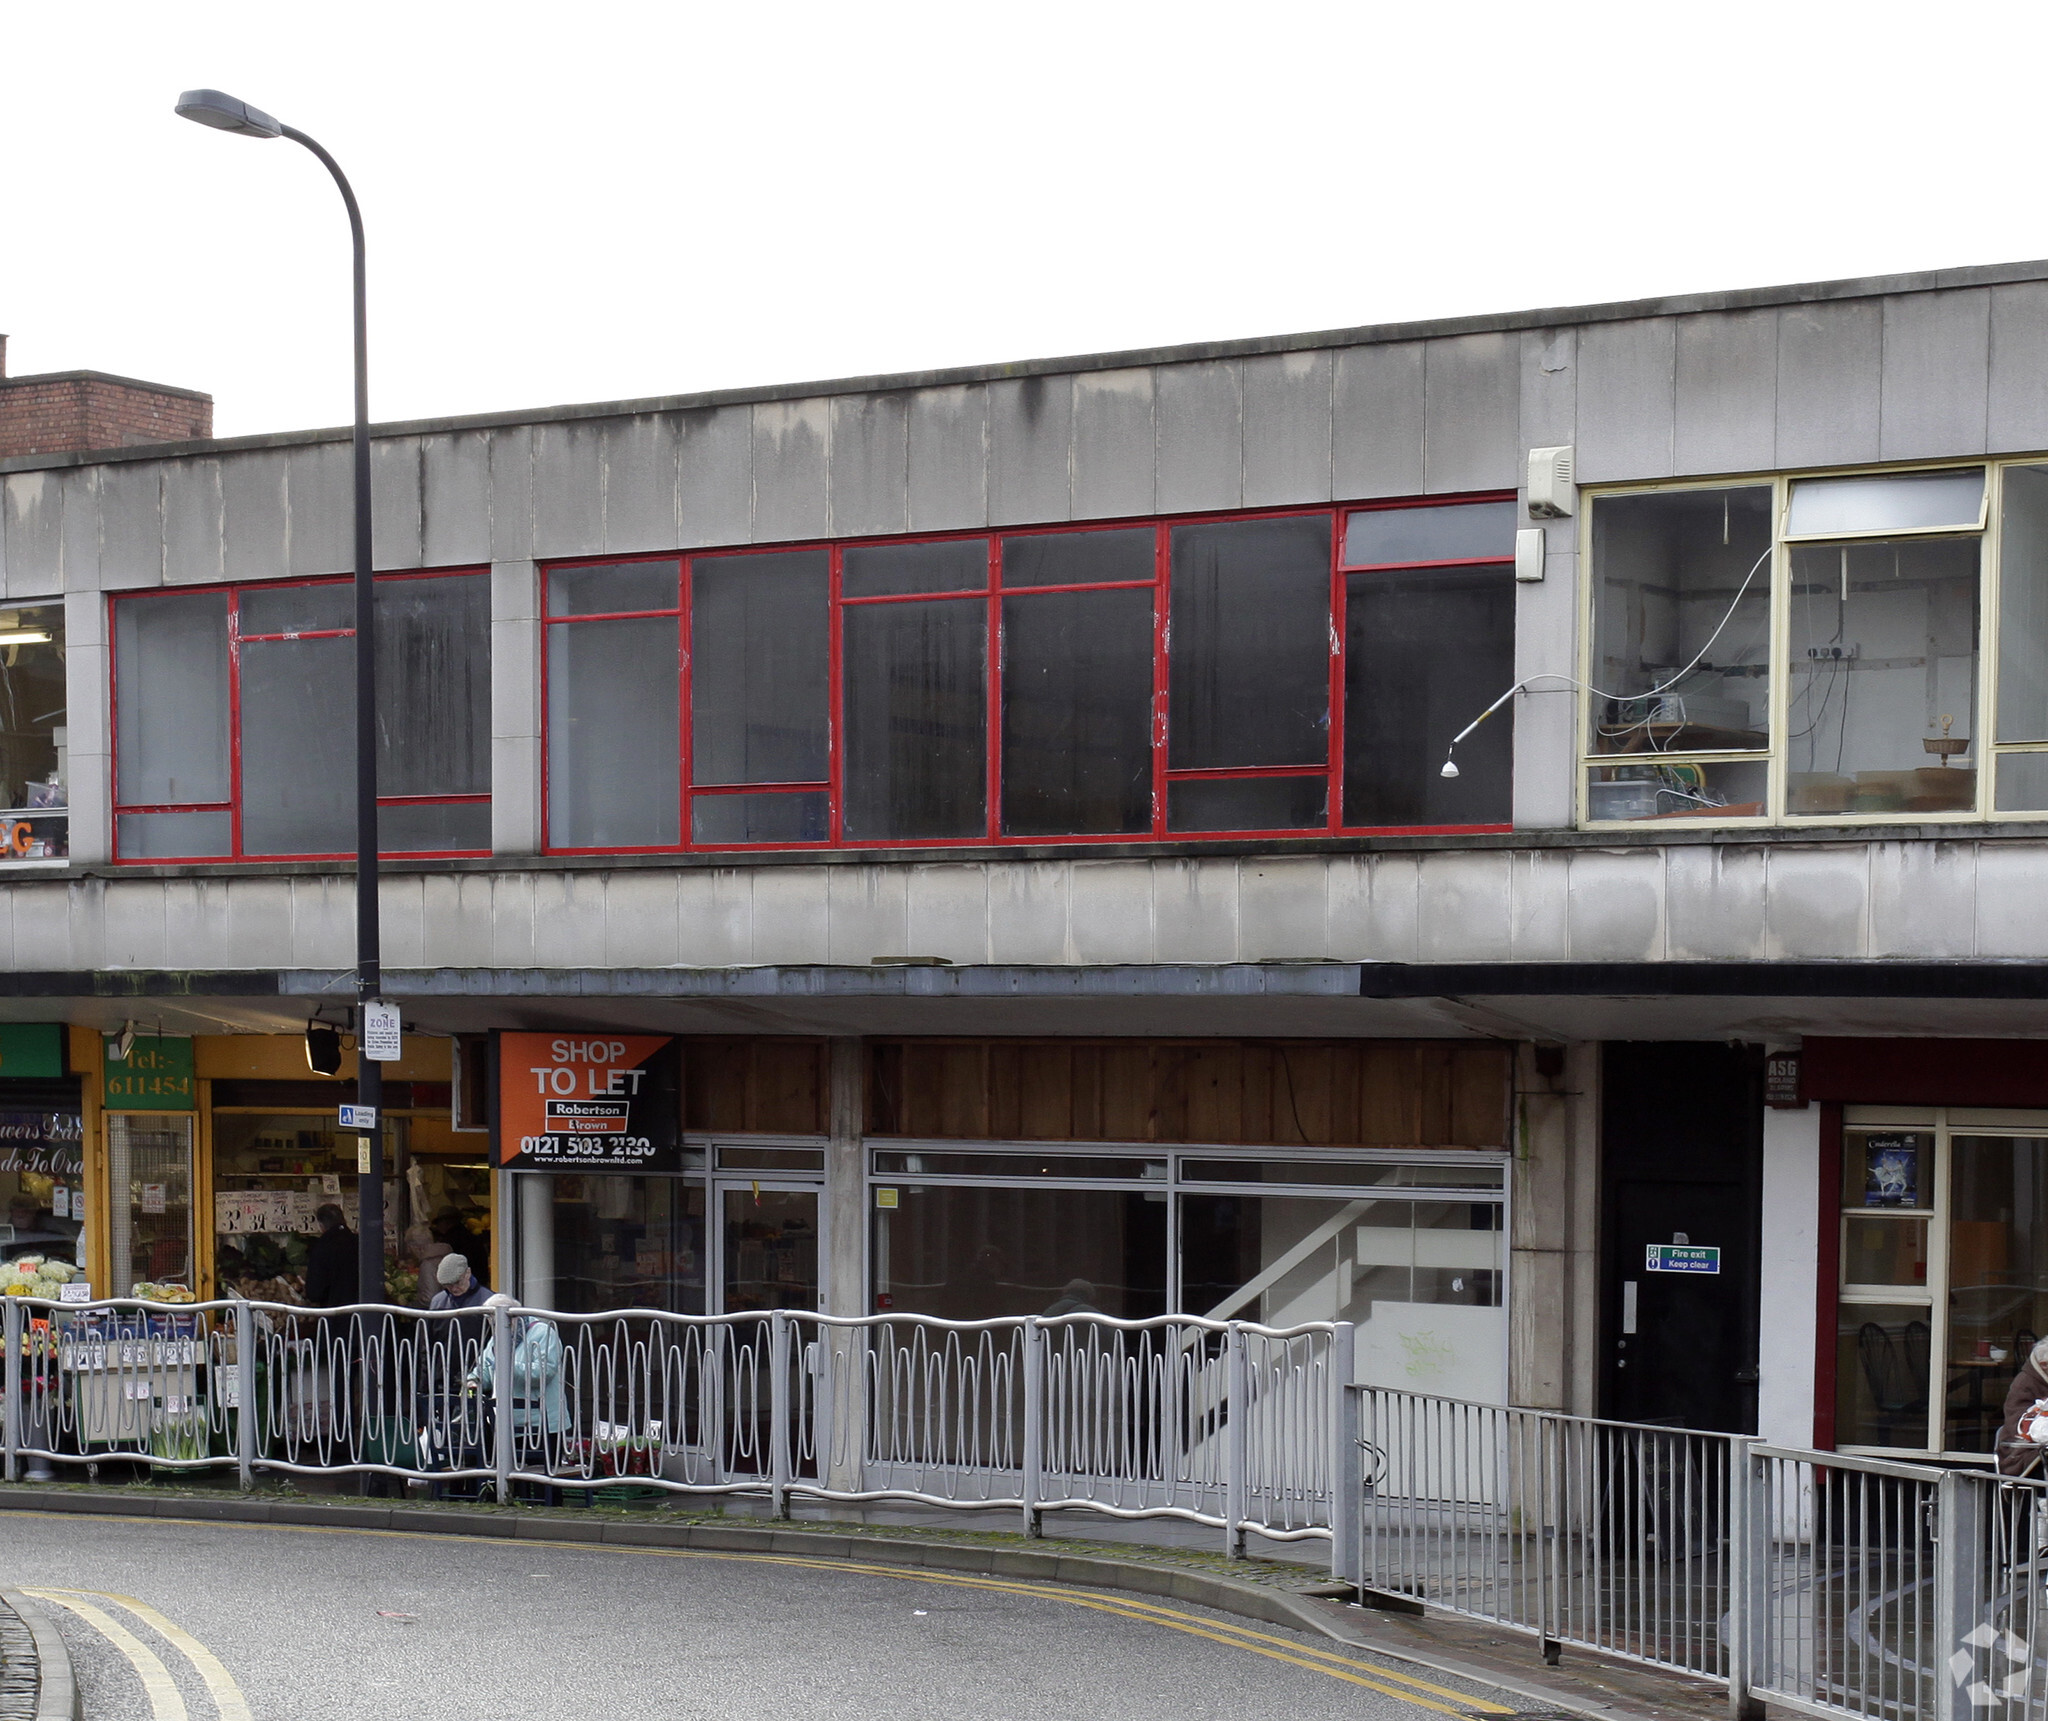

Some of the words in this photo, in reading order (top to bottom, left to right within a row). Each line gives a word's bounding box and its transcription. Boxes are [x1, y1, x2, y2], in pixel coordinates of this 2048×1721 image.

[370, 1018, 395, 1028] ZONE
[551, 1039, 626, 1063] SHOP
[1768, 1060, 1796, 1076] ASG
[108, 1076, 189, 1095] 611454
[530, 1067, 576, 1095] TO
[588, 1069, 647, 1096] LET
[556, 1104, 620, 1115] Robertson
[568, 1118, 608, 1130] Brown
[520, 1136, 560, 1154] 0121
[566, 1136, 604, 1155] 503
[608, 1136, 657, 1156] 2130
[1868, 1140, 1901, 1149] Cinderella
[534, 1155, 643, 1165] www.robertsonbrownltd.com
[1672, 1249, 1689, 1258] Fire
[1690, 1250, 1706, 1259] exit
[1668, 1260, 1688, 1269] Keep
[1689, 1261, 1709, 1269] clear
